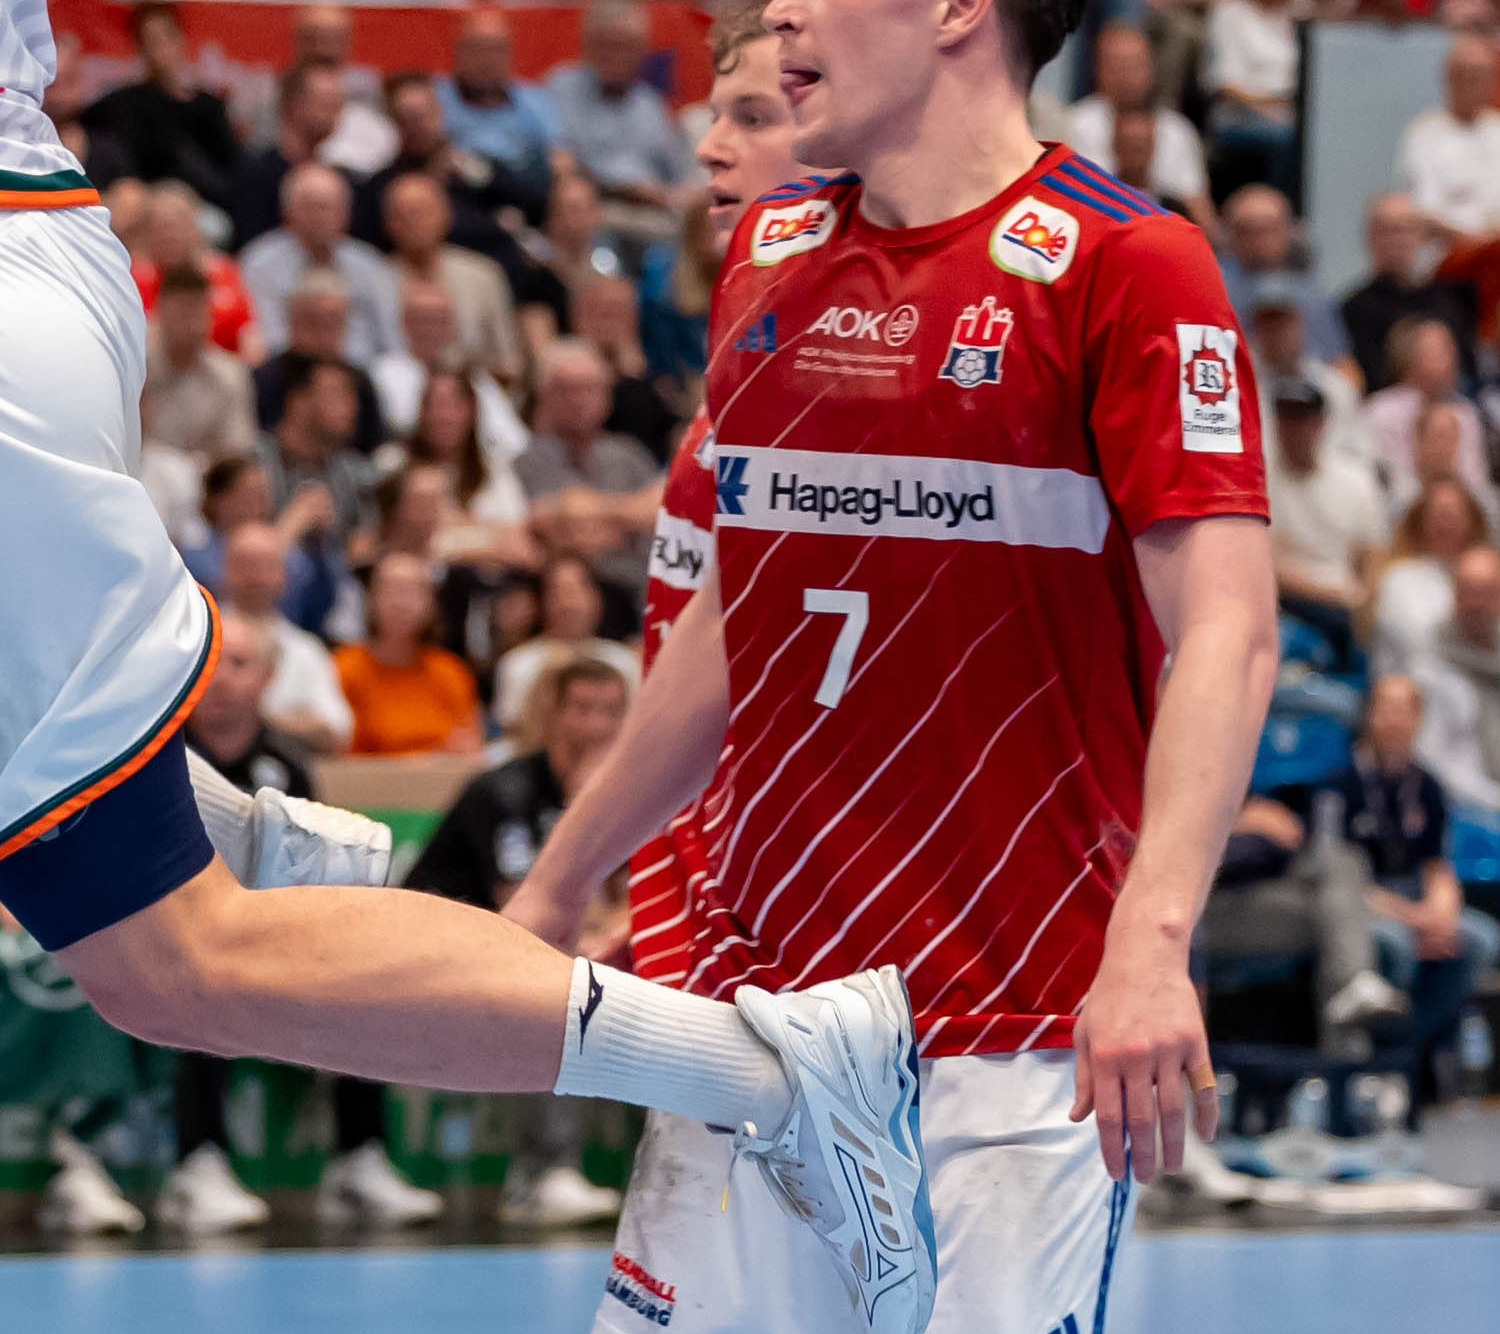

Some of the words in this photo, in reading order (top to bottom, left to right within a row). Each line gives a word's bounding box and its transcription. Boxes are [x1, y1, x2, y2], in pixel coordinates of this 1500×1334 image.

[1006, 210, 1068, 259] Dole
[804, 306, 889, 342] AOK
[769, 471, 997, 528] Hapag-Lloyd
[803, 587, 871, 710] 7
